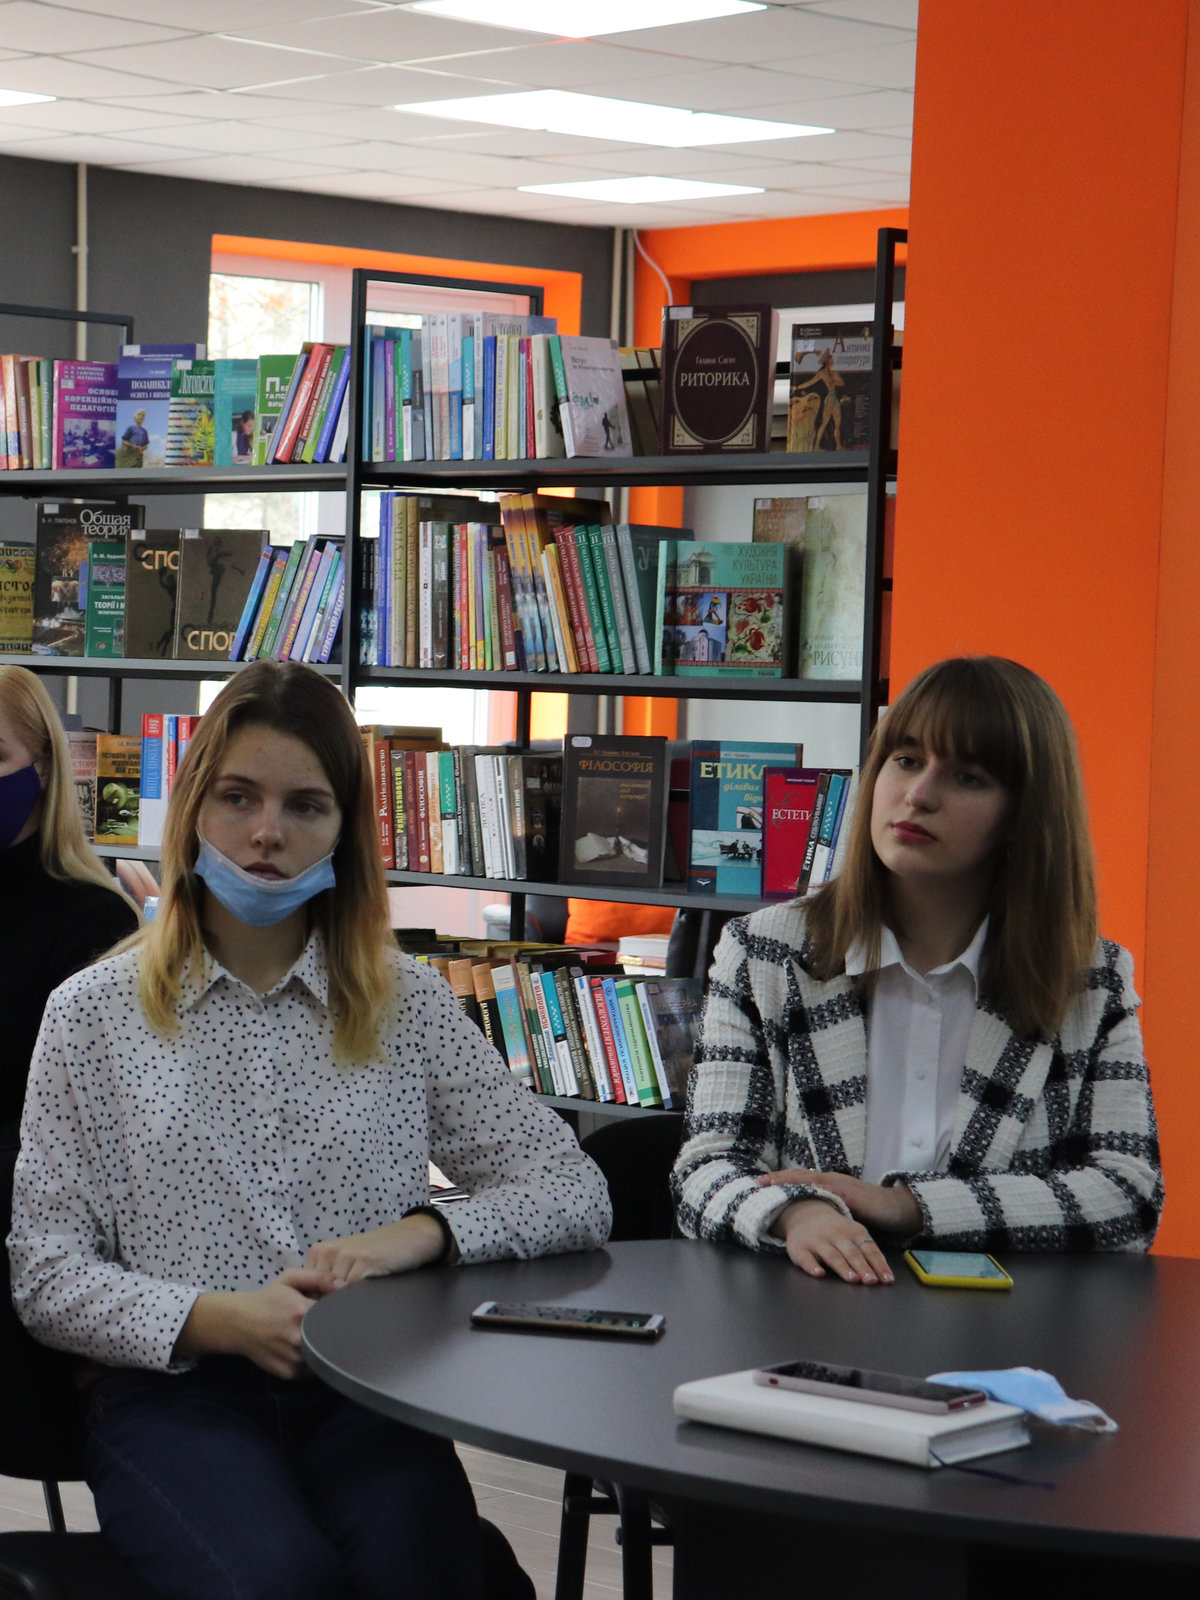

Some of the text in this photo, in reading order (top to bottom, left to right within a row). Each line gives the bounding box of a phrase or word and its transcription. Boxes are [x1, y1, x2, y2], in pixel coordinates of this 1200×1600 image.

[680, 372, 750, 387] РИТОРИКА
[80, 508, 131, 526] Общая
[82, 524, 131, 539] теория
[732, 558, 778, 571] КУЛЬТУРА
[741, 572, 778, 586] УКРАЇНИ
[94, 600, 115, 609] ТЕОРІЇ
[320, 615, 338, 657] ТУРИСТИЧНІ
[578, 760, 654, 773] ФІЛОСОФІЯ
[700, 762, 767, 780] ЕТИКА
[379, 749, 388, 817] Релігієзнавство
[723, 782, 760, 792] ділових
[417, 770, 426, 819] ФІЛОСОФІЯ
[802, 793, 825, 871] ЕТИКА СПІЛКУВАННЯ
[534, 985, 549, 1030] ПСИХОЛОГІЯ
[593, 991, 612, 1045] ПСИХОЛОГІЯ
